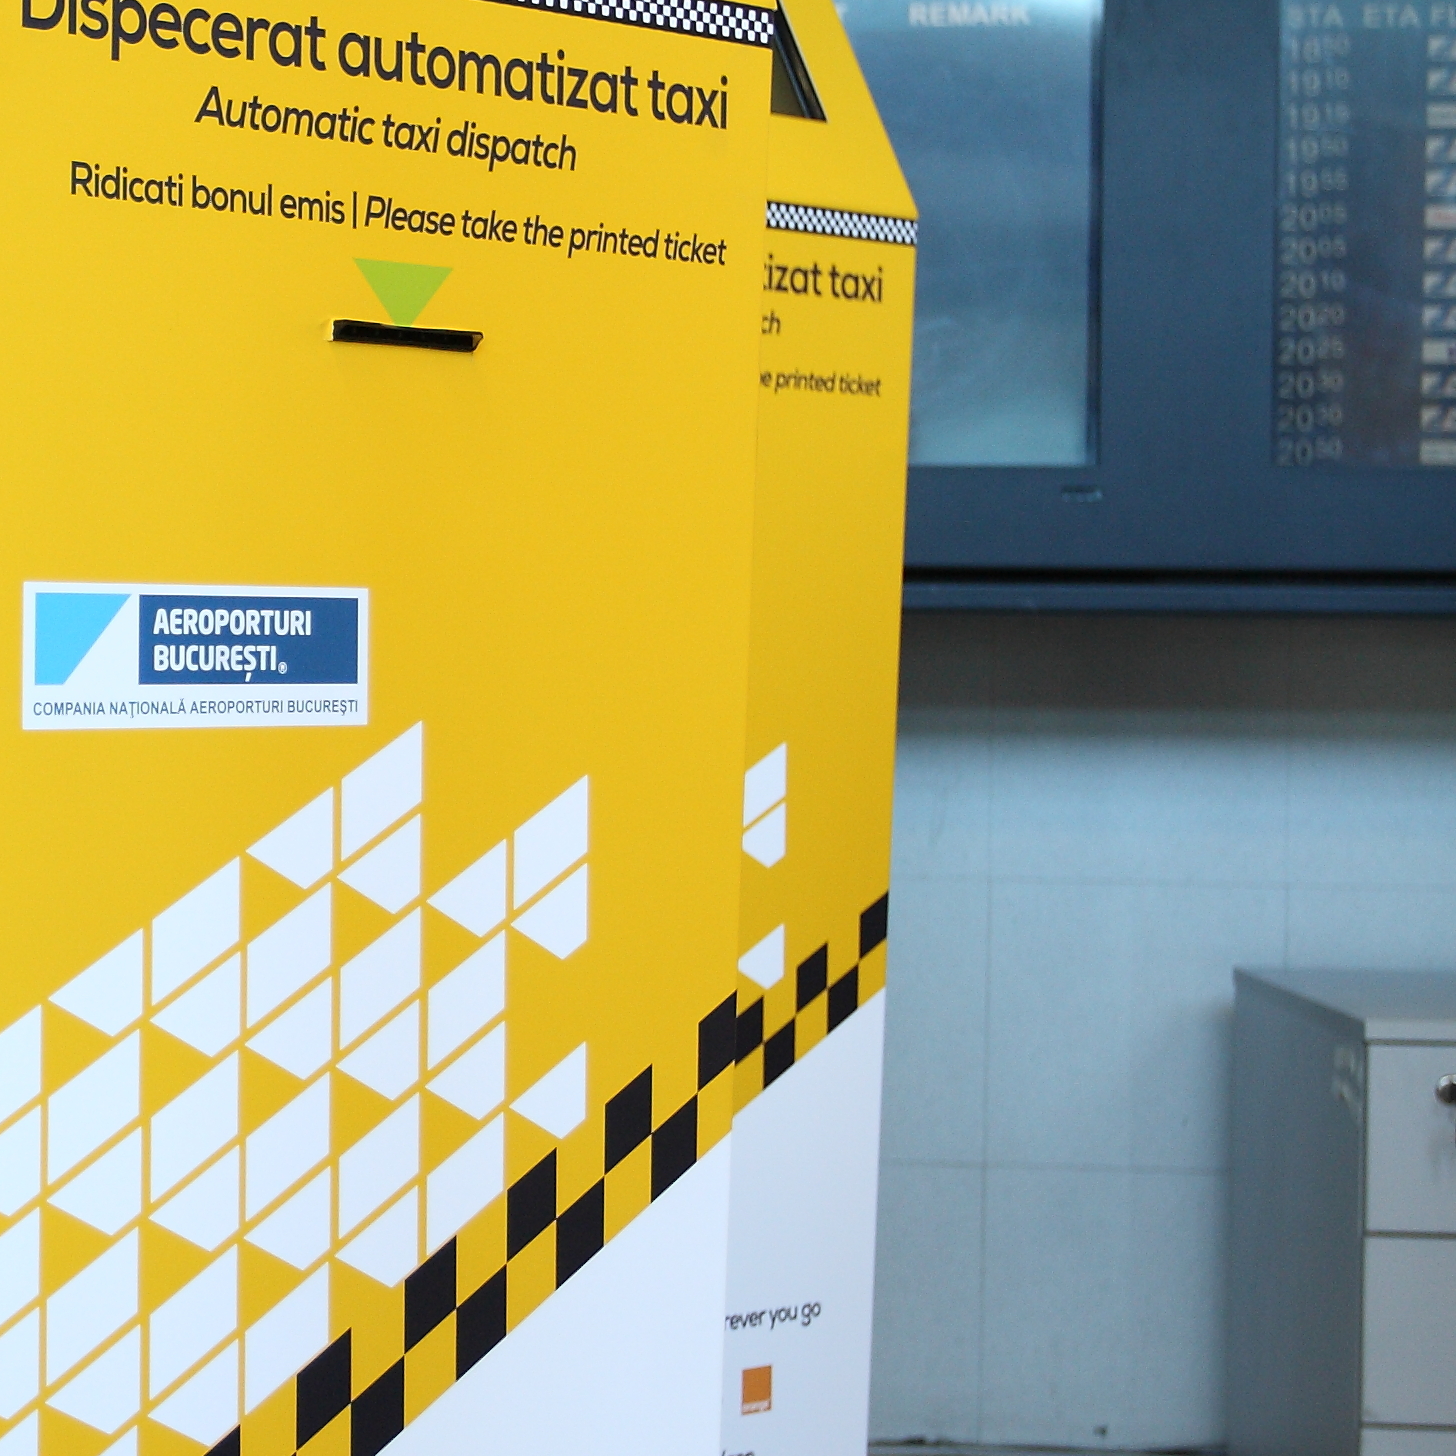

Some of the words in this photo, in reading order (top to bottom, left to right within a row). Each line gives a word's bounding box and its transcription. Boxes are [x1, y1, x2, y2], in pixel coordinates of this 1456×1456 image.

[909, 0, 1031, 28] REMARK
[1363, 3, 1421, 29] ETA
[338, 28, 637, 117] automatizat
[649, 75, 728, 129] taxi
[194, 84, 374, 146] Automatic
[381, 117, 440, 155] taxi
[446, 124, 577, 173] dispatch
[70, 160, 184, 208] Ridicati
[191, 174, 273, 219] bonul
[279, 191, 345, 225] emis
[364, 195, 455, 238] Please
[460, 210, 518, 245] take
[522, 216, 563, 250] the
[568, 222, 658, 261] printed
[663, 230, 728, 267] ticket
[829, 264, 883, 303] taxi
[775, 369, 836, 393] printed
[839, 373, 882, 397] ticket
[153, 608, 312, 636] AEROPORTURI
[33, 700, 106, 717] COMPANIA
[189, 700, 284, 715] AEROPORTURI
[769, 1306, 798, 1330] you
[801, 1302, 821, 1327] go
